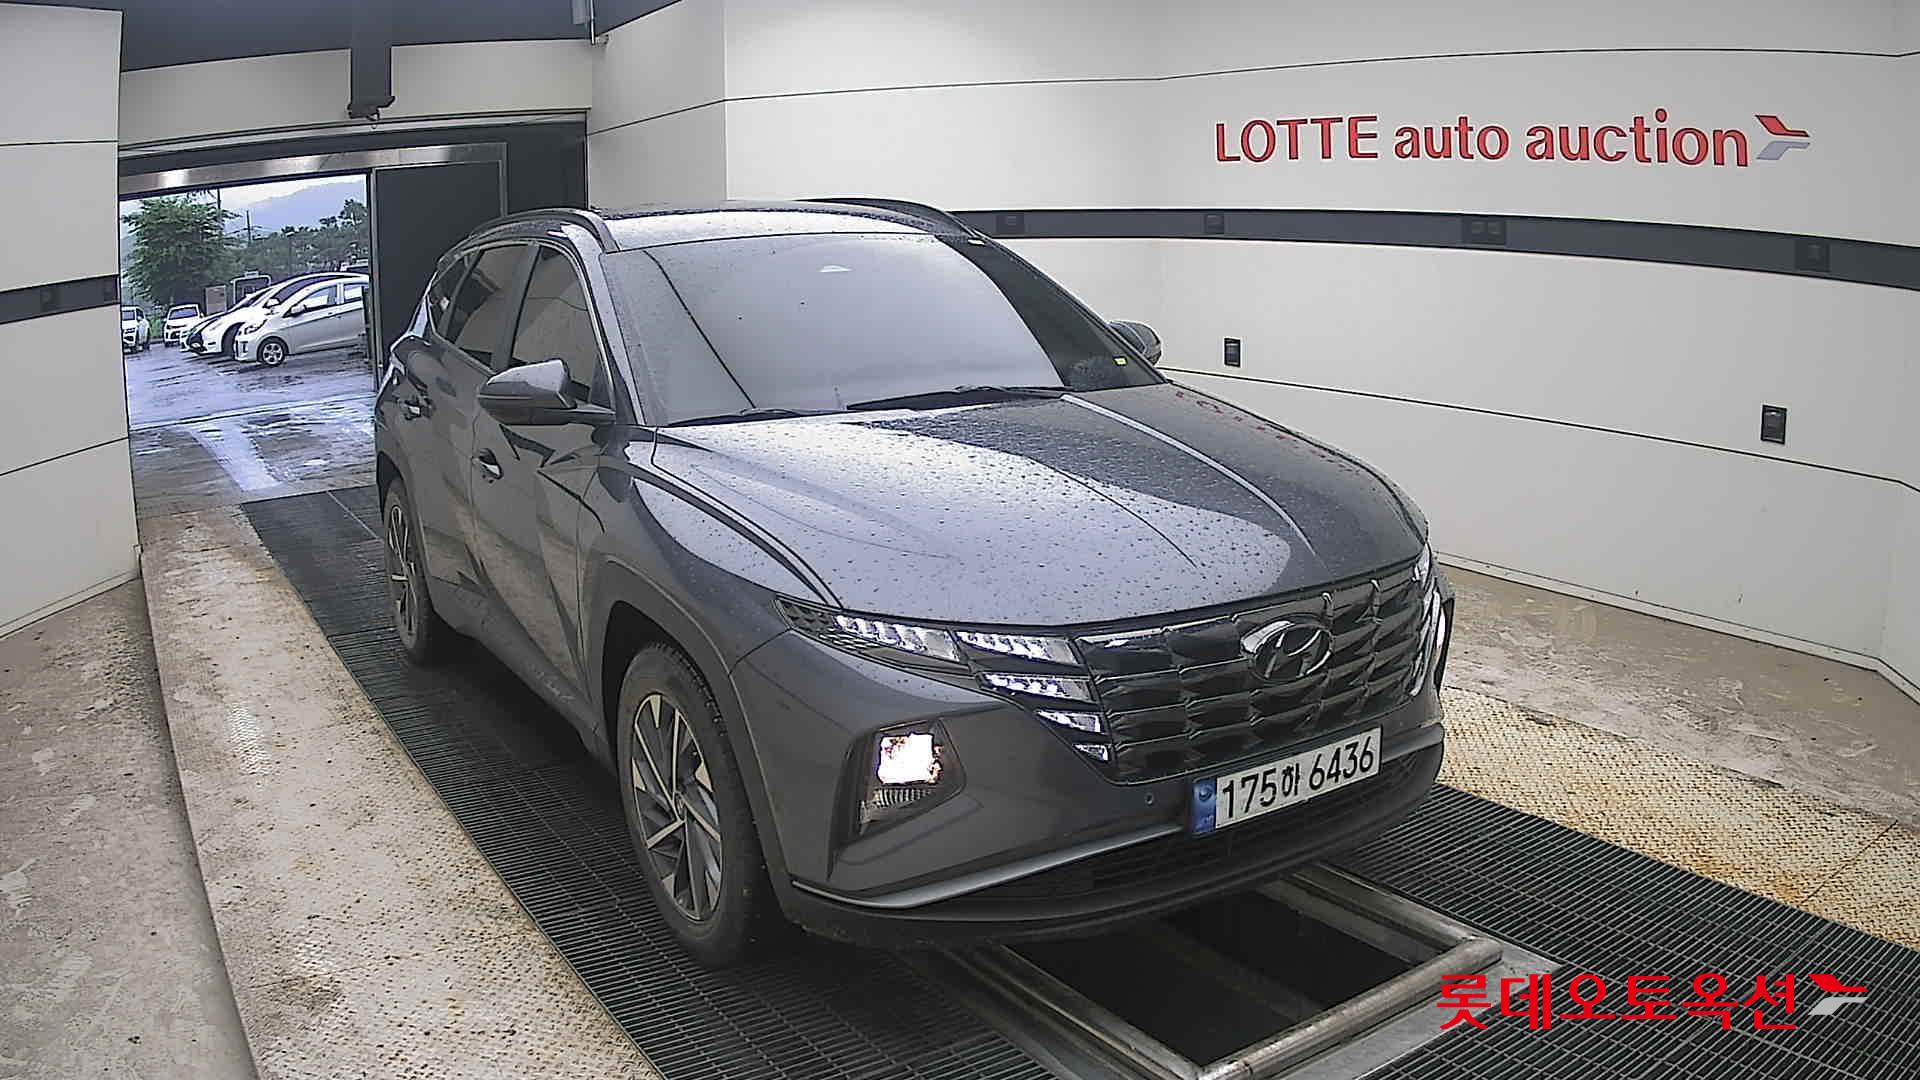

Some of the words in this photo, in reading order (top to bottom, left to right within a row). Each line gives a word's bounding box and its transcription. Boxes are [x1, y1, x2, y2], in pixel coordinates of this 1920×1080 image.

[1214, 115, 1377, 163] LOTTE
[1394, 117, 1510, 161] auto
[1526, 109, 1750, 168] auction
[1222, 762, 1302, 819] 175하
[1308, 736, 1374, 790] 6436
